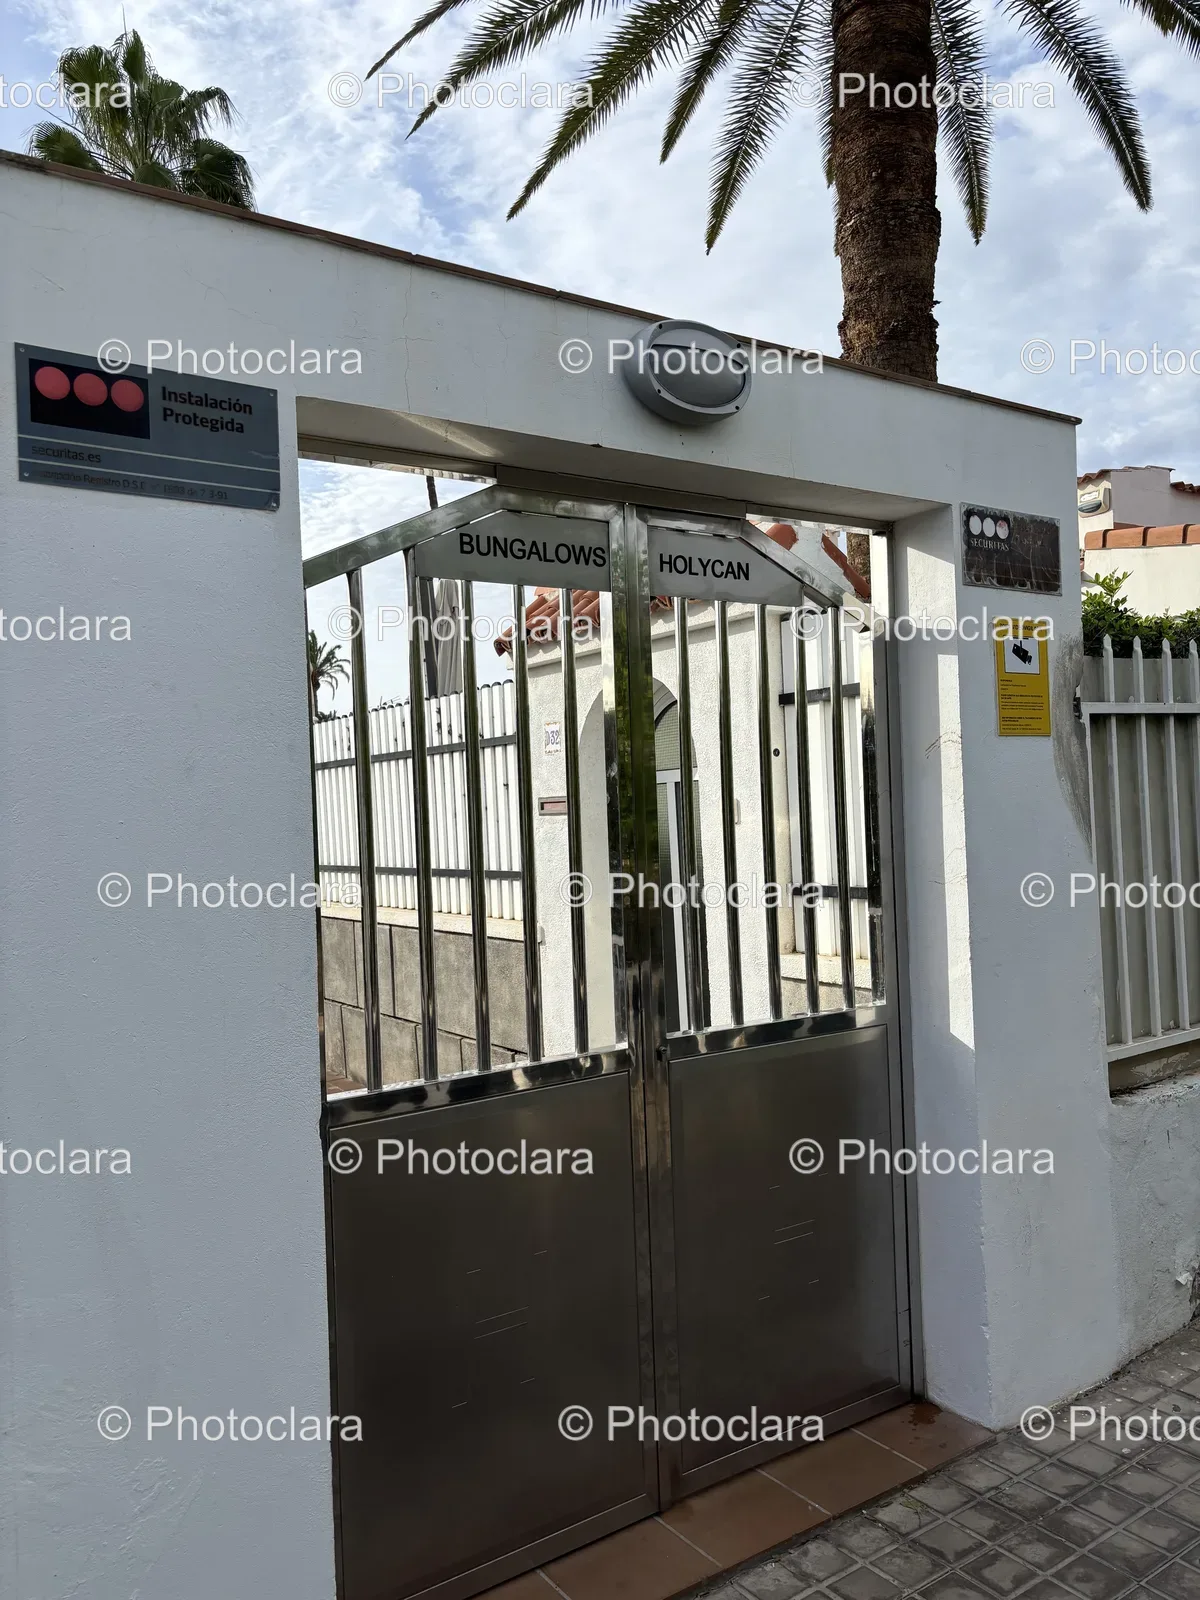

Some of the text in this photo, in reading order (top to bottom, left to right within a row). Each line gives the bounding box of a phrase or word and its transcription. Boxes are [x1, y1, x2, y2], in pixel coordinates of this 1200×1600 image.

[162, 386, 253, 415] Instalación
[162, 406, 245, 434] Protegida
[31, 445, 102, 463] securitas.es
[459, 532, 607, 567] BUNGALOWS
[969, 537, 1010, 552] SECURITAS
[659, 553, 750, 581] HOLYCAN
